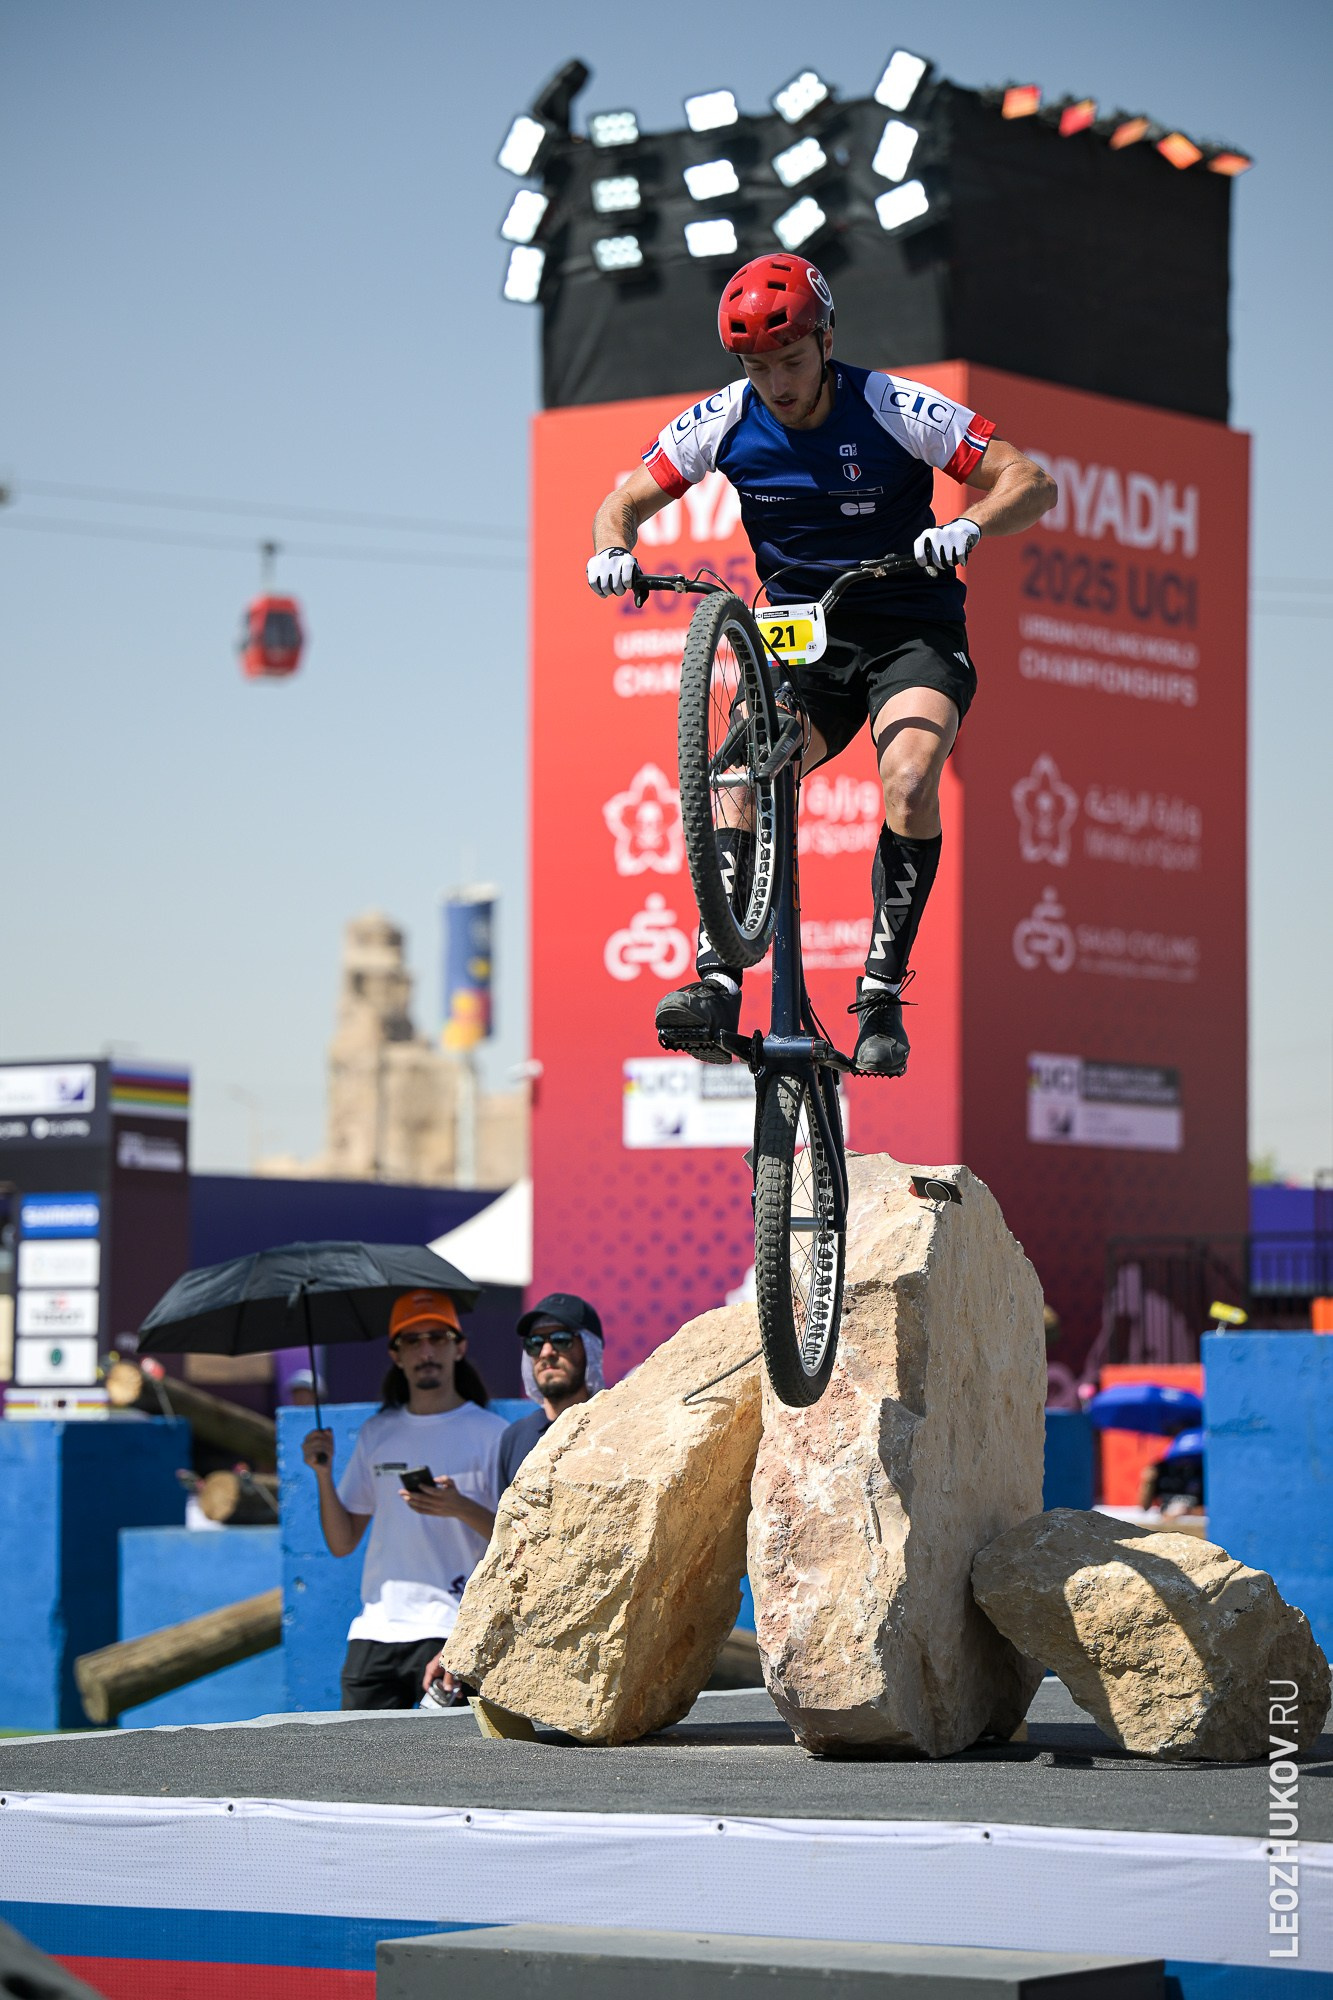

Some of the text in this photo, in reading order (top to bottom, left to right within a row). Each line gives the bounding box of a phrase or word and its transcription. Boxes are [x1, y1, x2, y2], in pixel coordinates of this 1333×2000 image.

[677, 393, 724, 432] CIC
[889, 391, 948, 424] CIC
[1022, 543, 1198, 631] 2025 UCI
[769, 625, 796, 648] 21
[869, 862, 918, 960] WAW
